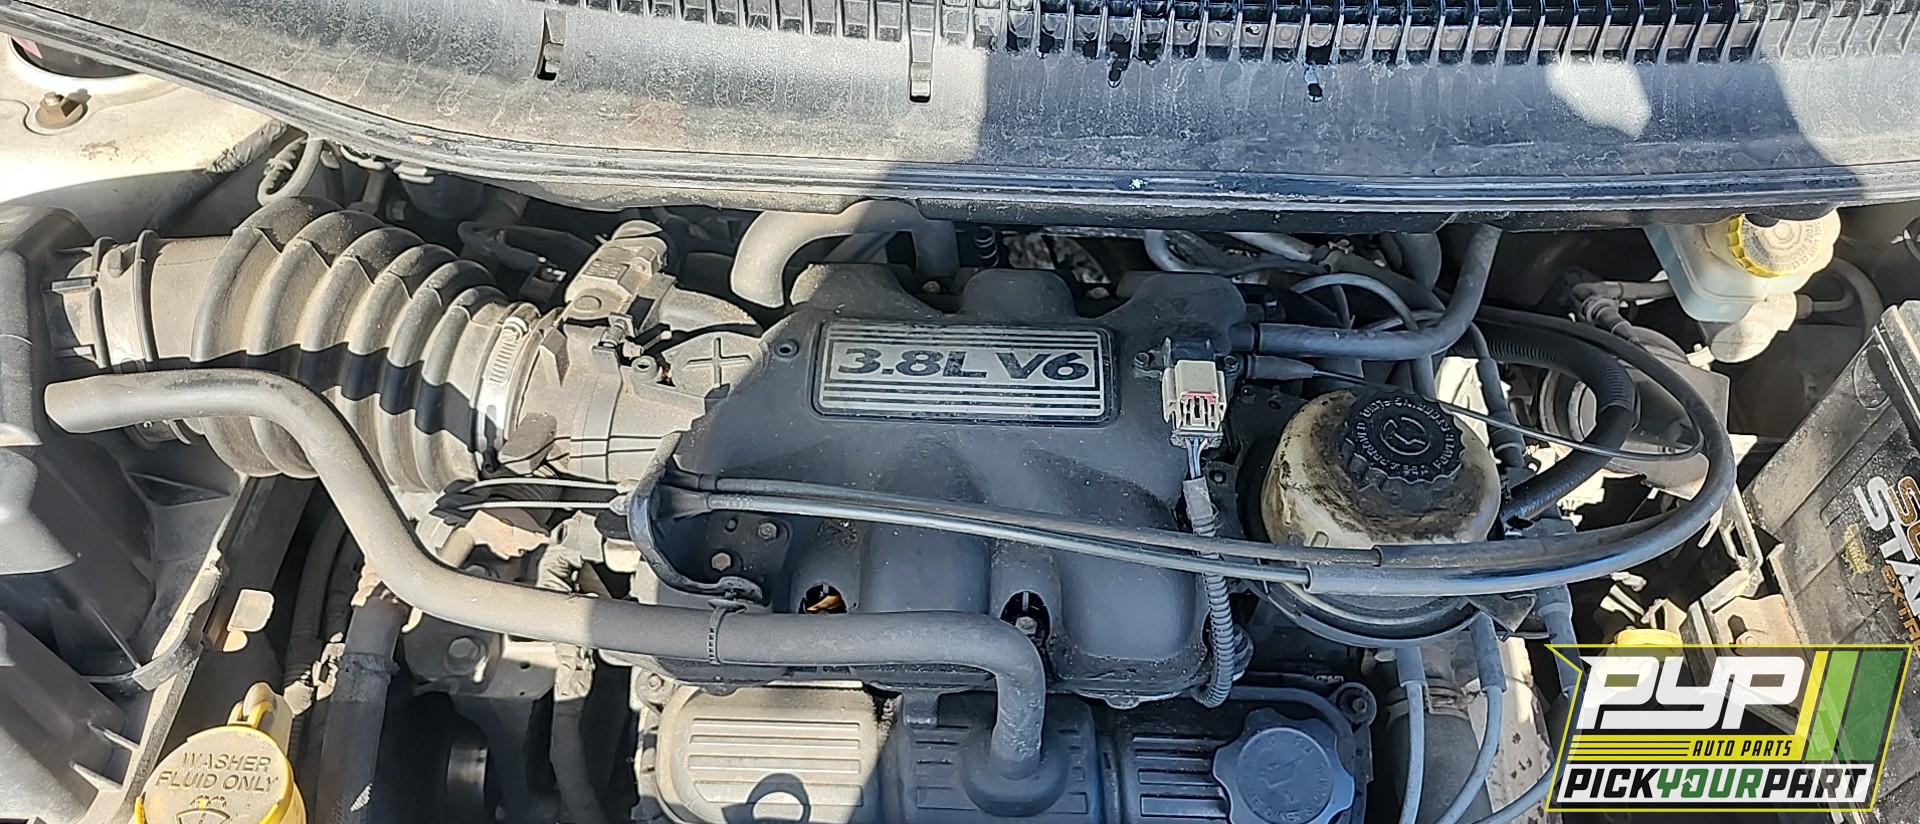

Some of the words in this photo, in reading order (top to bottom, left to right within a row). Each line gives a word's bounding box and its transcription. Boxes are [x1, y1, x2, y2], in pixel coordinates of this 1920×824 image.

[838, 348, 987, 378] 3.8L
[996, 350, 1089, 380] V6
[1854, 476, 1920, 619] STA
[181, 752, 271, 773] WASHER
[155, 771, 218, 790] FLUID
[222, 774, 279, 792] ONLY
